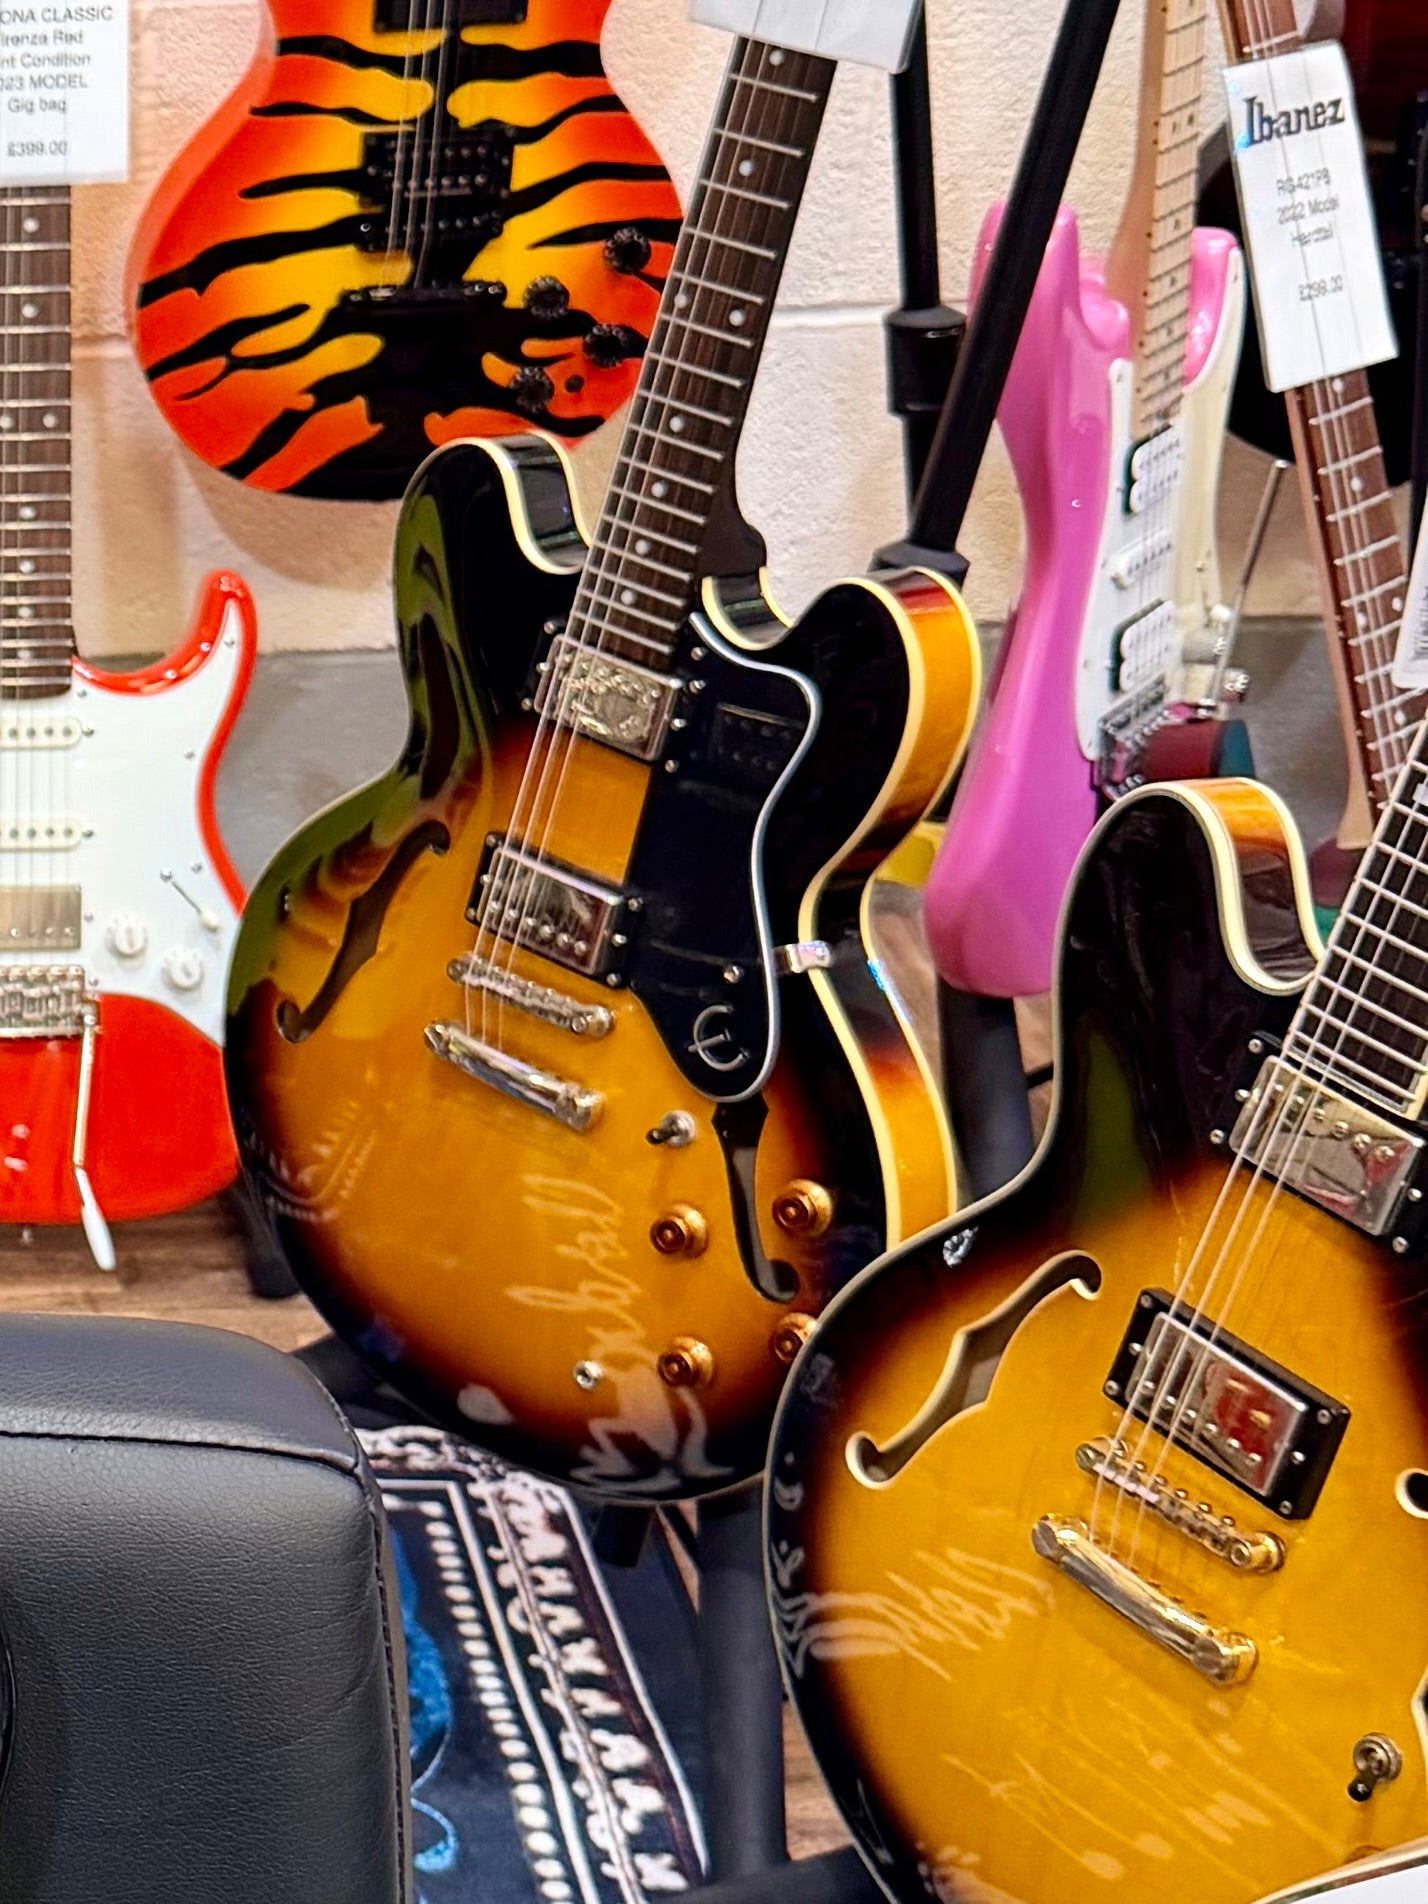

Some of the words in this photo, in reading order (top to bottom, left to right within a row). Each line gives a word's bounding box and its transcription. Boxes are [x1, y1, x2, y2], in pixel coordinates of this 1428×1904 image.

[41, 5, 113, 23] CLASSIC
[53, 29, 84, 45] Red
[20, 53, 91, 69] Condition
[29, 75, 88, 90] MODEL
[7, 97, 34, 114] Gig
[39, 96, 67, 114] bag
[1243, 96, 1346, 146] Ibanez
